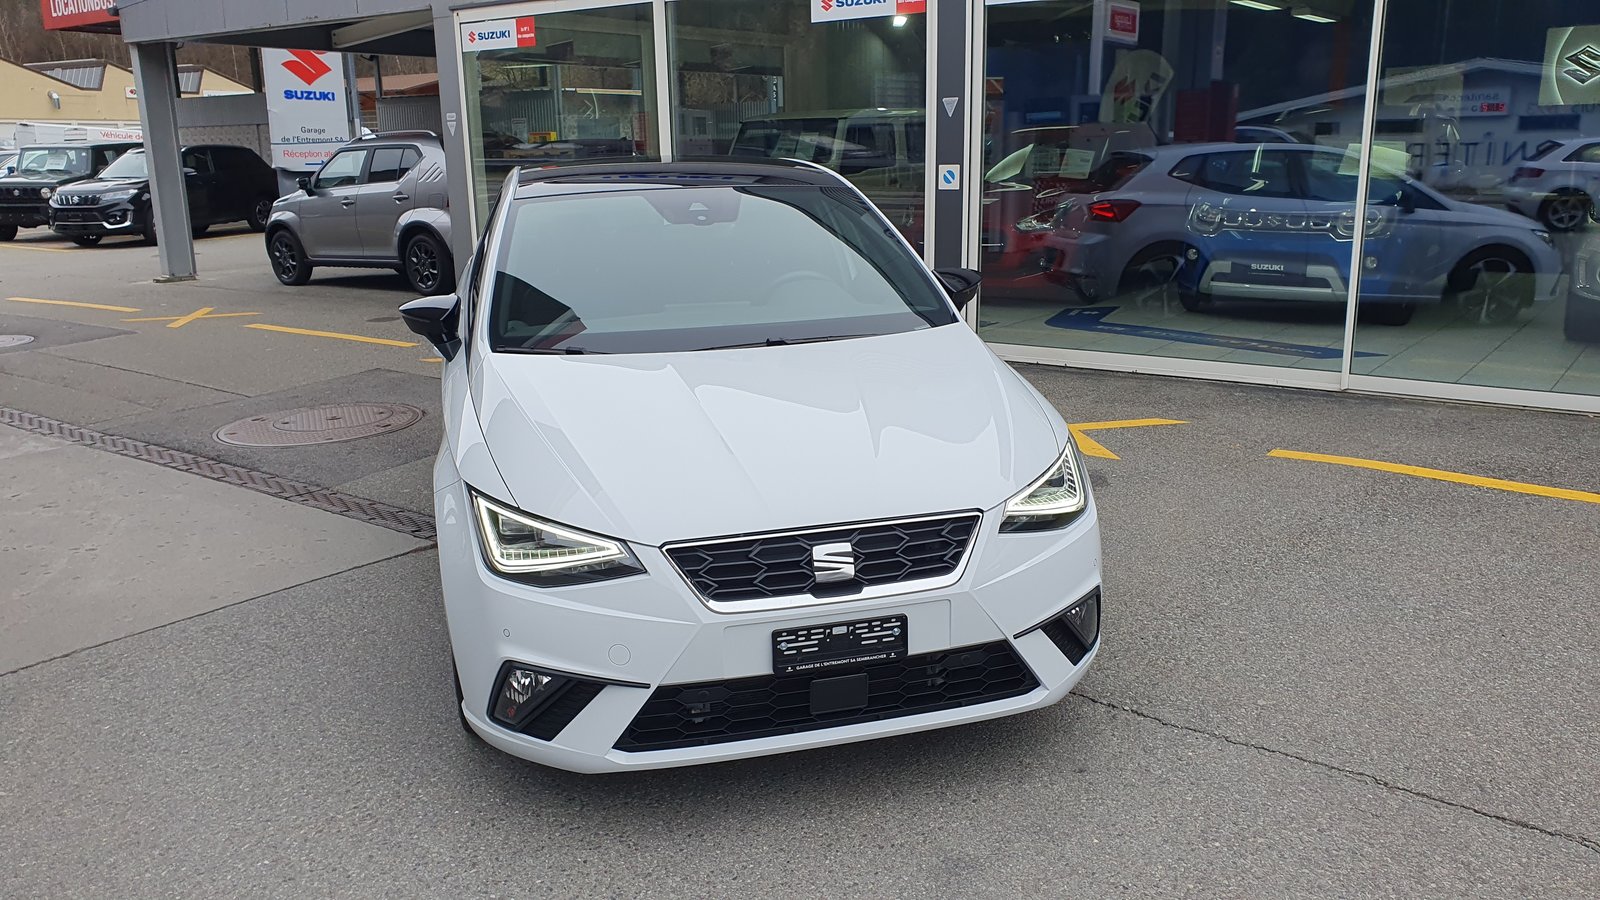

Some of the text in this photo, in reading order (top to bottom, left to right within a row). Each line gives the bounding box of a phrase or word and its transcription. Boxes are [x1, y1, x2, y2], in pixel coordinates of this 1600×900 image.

[477, 30, 511, 40] SUZUKI
[284, 89, 336, 101] SUZUKI
[100, 130, 134, 139] Véhicule
[300, 126, 326, 135] Garage
[283, 149, 323, 159] Réception
[1251, 263, 1284, 271] SUZUKI
[820, 658, 850, 667] L'ENTREMONT
[856, 654, 887, 662] SEMBRANCHER
